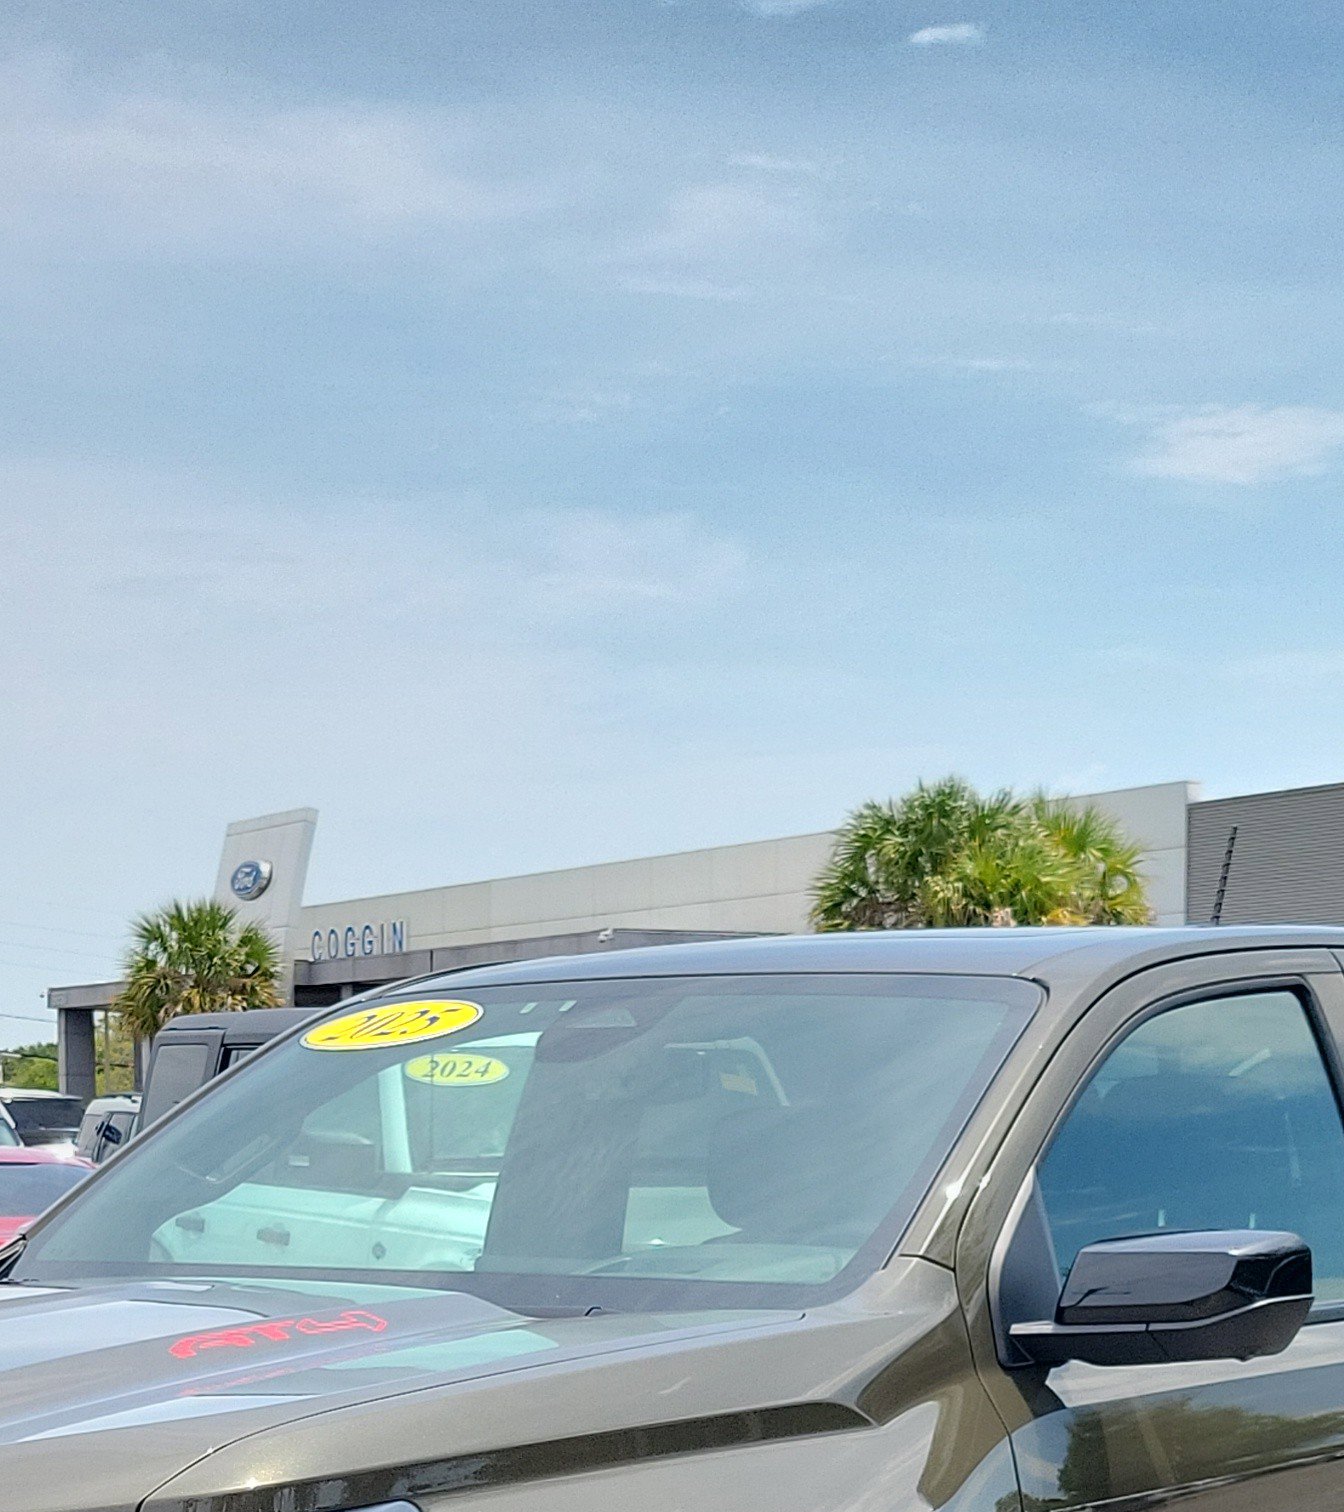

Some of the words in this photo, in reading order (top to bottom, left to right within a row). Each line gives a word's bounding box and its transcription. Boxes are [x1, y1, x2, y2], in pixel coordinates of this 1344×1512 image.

[311, 920, 405, 961] COGGIN
[319, 1007, 464, 1042] 2025
[421, 1058, 494, 1080] 2024
[168, 1310, 389, 1359] AT4
